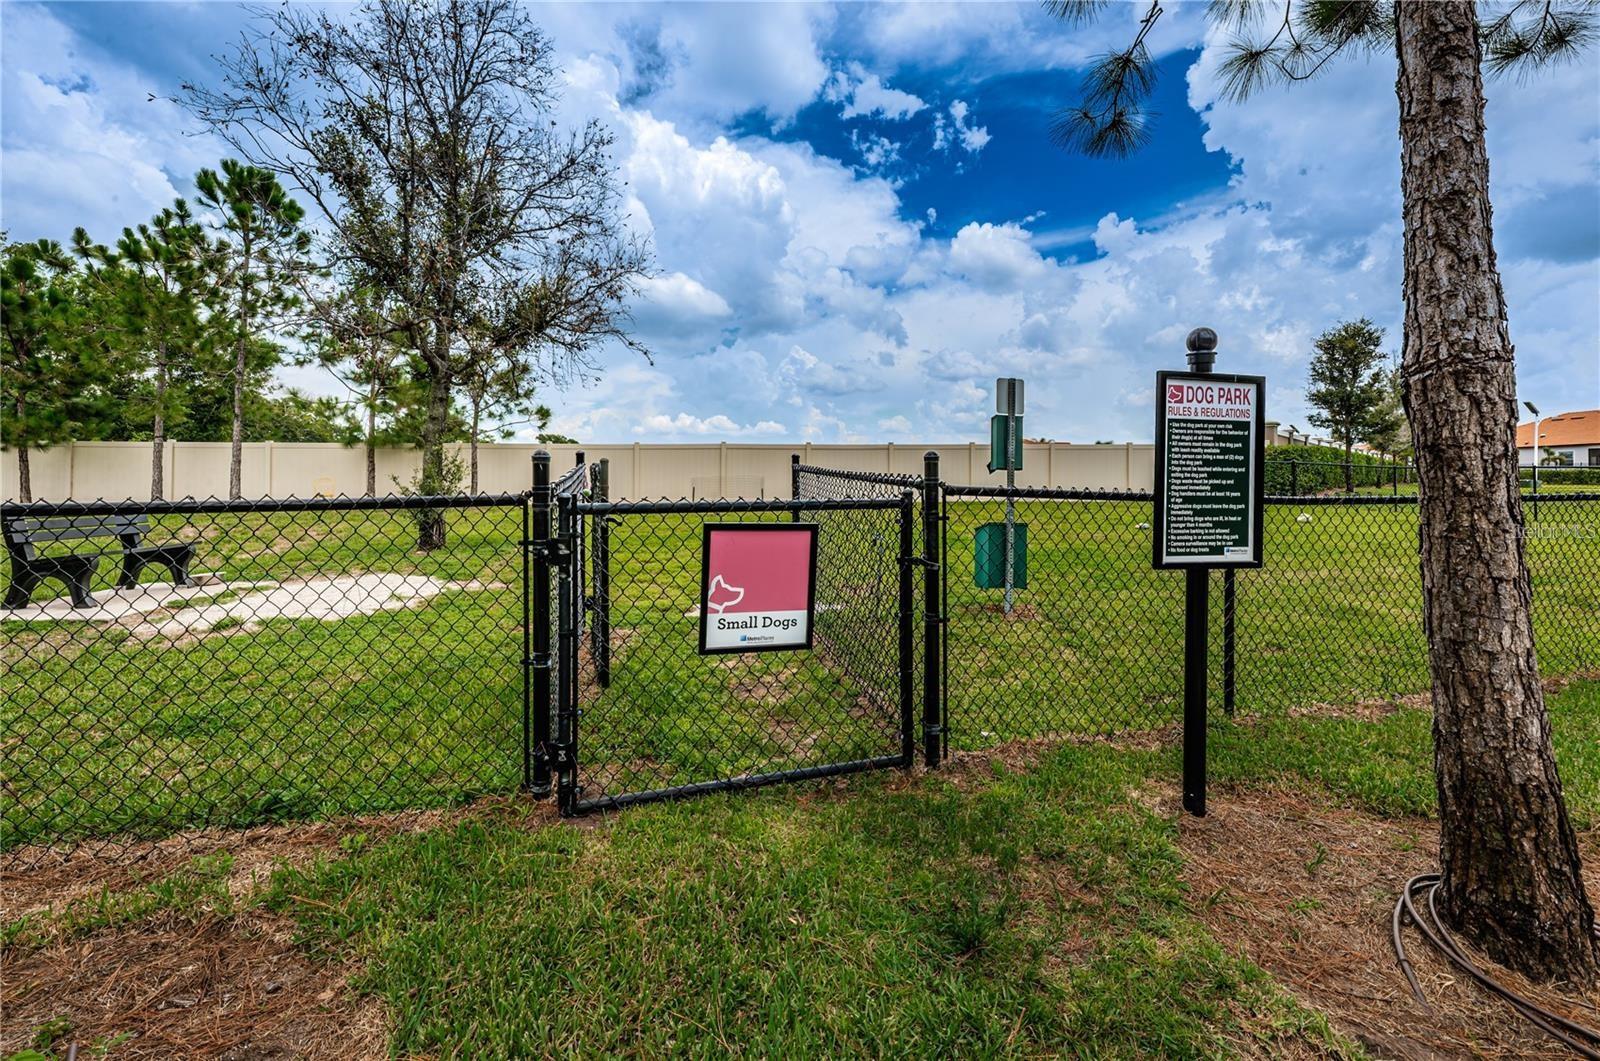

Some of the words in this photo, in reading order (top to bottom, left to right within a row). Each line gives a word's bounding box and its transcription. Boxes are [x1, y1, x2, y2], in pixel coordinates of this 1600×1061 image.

[1186, 386, 1213, 404] DOG
[1218, 388, 1251, 405] PARK
[1168, 406, 1191, 416] RULES
[1194, 407, 1198, 416] &
[1201, 407, 1250, 418] REGULATIONS
[718, 616, 757, 630] Small
[762, 617, 797, 630] Dogs
